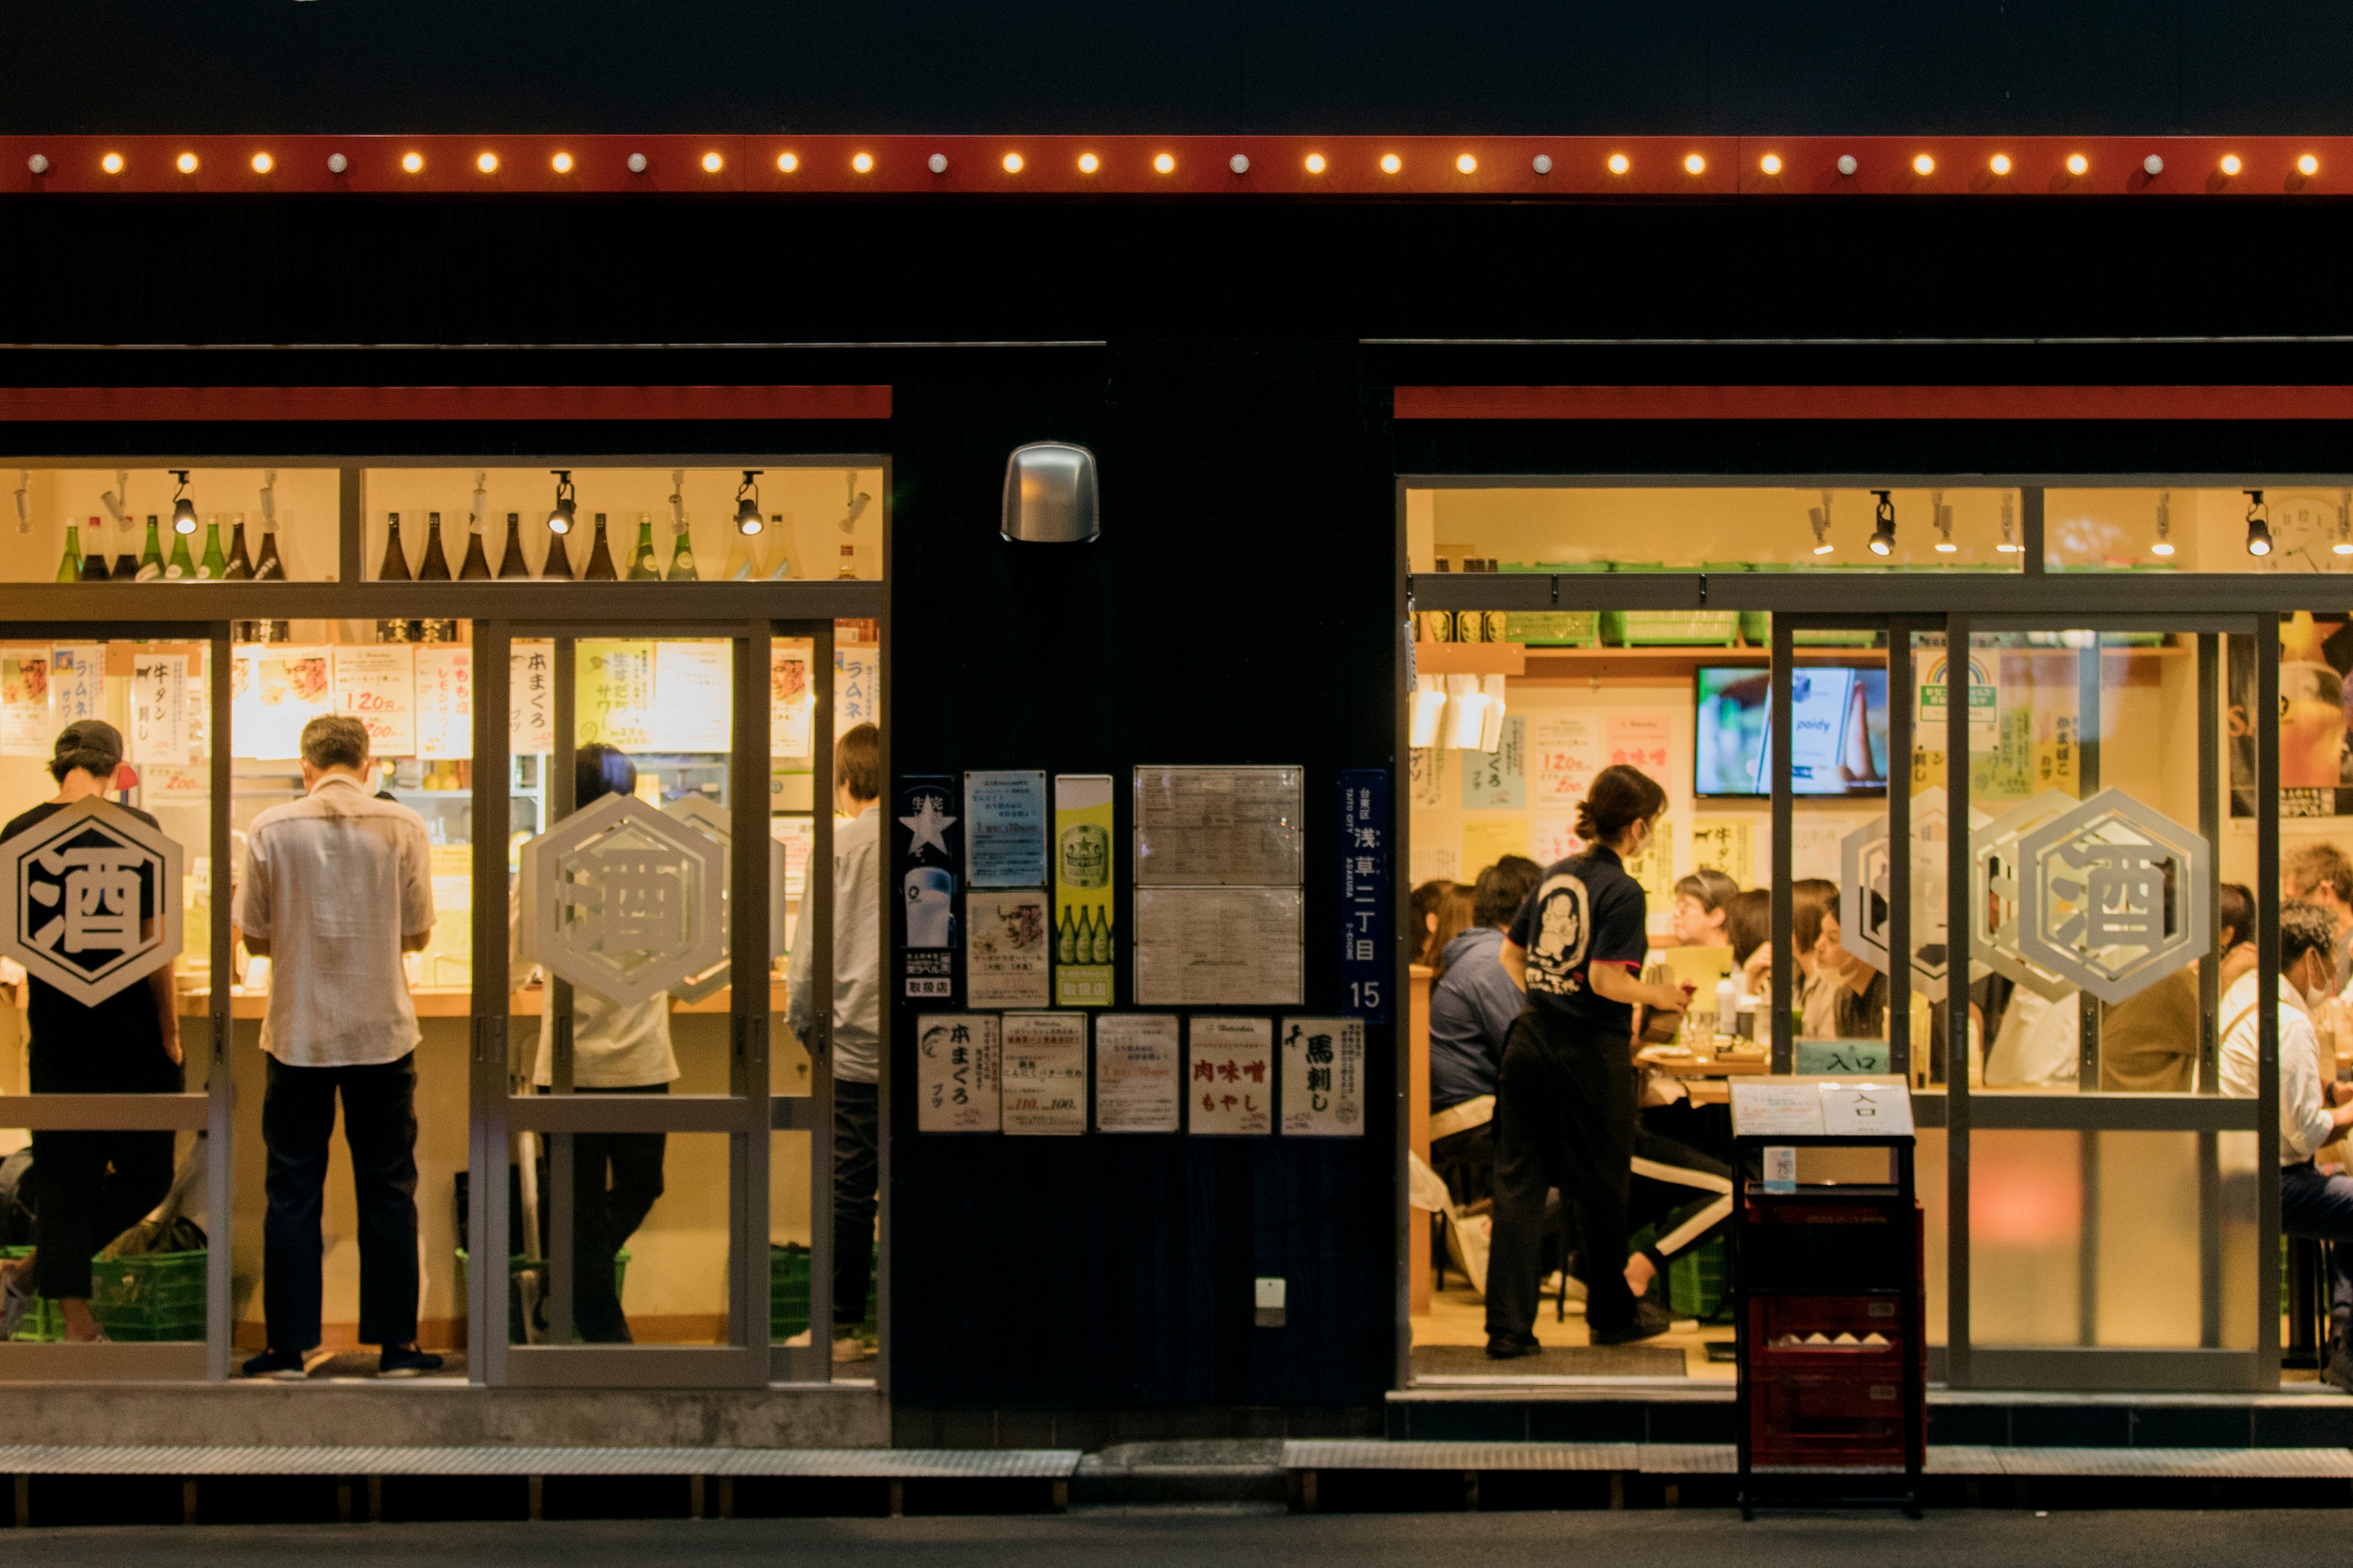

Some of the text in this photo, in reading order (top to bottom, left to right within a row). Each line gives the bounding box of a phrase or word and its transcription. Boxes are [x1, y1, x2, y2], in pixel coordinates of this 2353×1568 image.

[74, 661, 87, 717] ラムネ
[153, 661, 169, 721] 牛タン
[347, 692, 394, 710] 120円
[454, 668, 469, 714] もも塩
[527, 652, 546, 728] 本まぐろ
[596, 684, 612, 731] サワー
[613, 652, 630, 714] 生すだち
[844, 661, 862, 720] ラムネ
[1360, 787, 1371, 820] 台東区
[29, 842, 144, 953] 酒
[1354, 827, 1376, 961] 浅草二丁目
[2049, 844, 2166, 951] 酒
[909, 982, 948, 993] 取扱店
[1350, 980, 1381, 1008] 15
[950, 1023, 971, 1105] 本まぐろ
[1193, 1058, 1265, 1084] 肉味噌
[1305, 1034, 1334, 1113] 馬刺し
[1827, 1053, 1876, 1072] 入口
[1202, 1093, 1258, 1113] もやし
[1853, 1093, 1877, 1117] 入口
